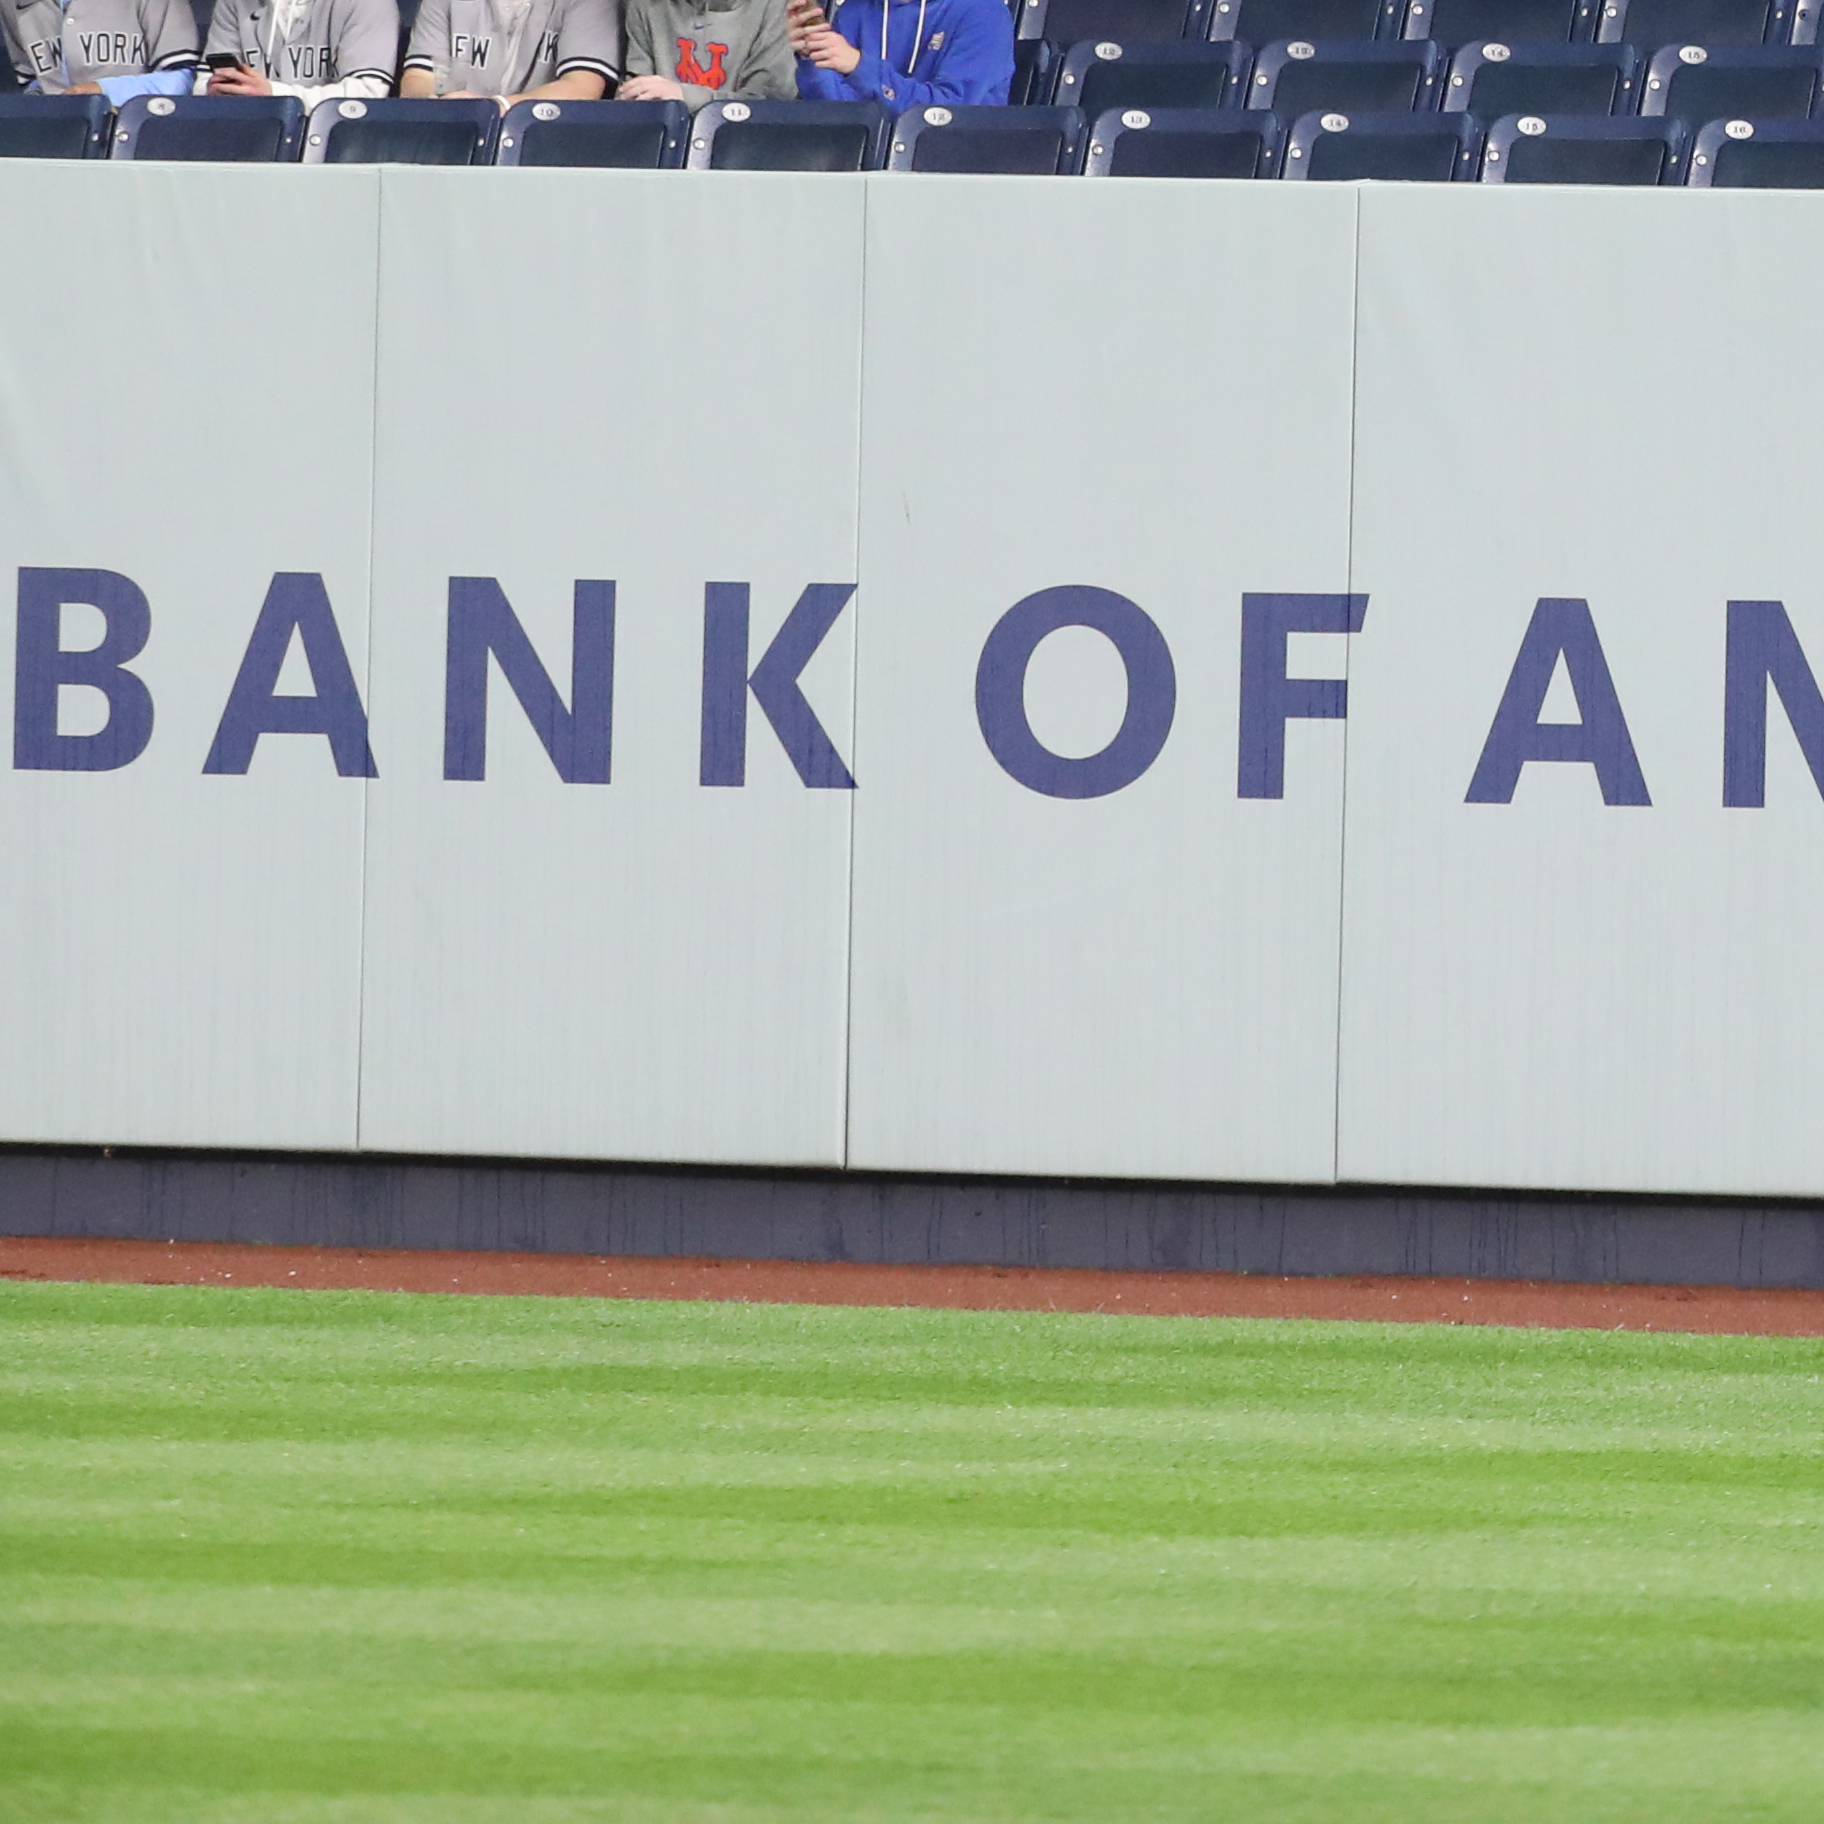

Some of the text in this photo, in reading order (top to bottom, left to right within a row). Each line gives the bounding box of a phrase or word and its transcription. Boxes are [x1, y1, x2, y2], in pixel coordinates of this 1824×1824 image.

[79, 32, 151, 66] YORK
[13, 567, 859, 789] BANK
[977, 586, 1369, 802] OF
